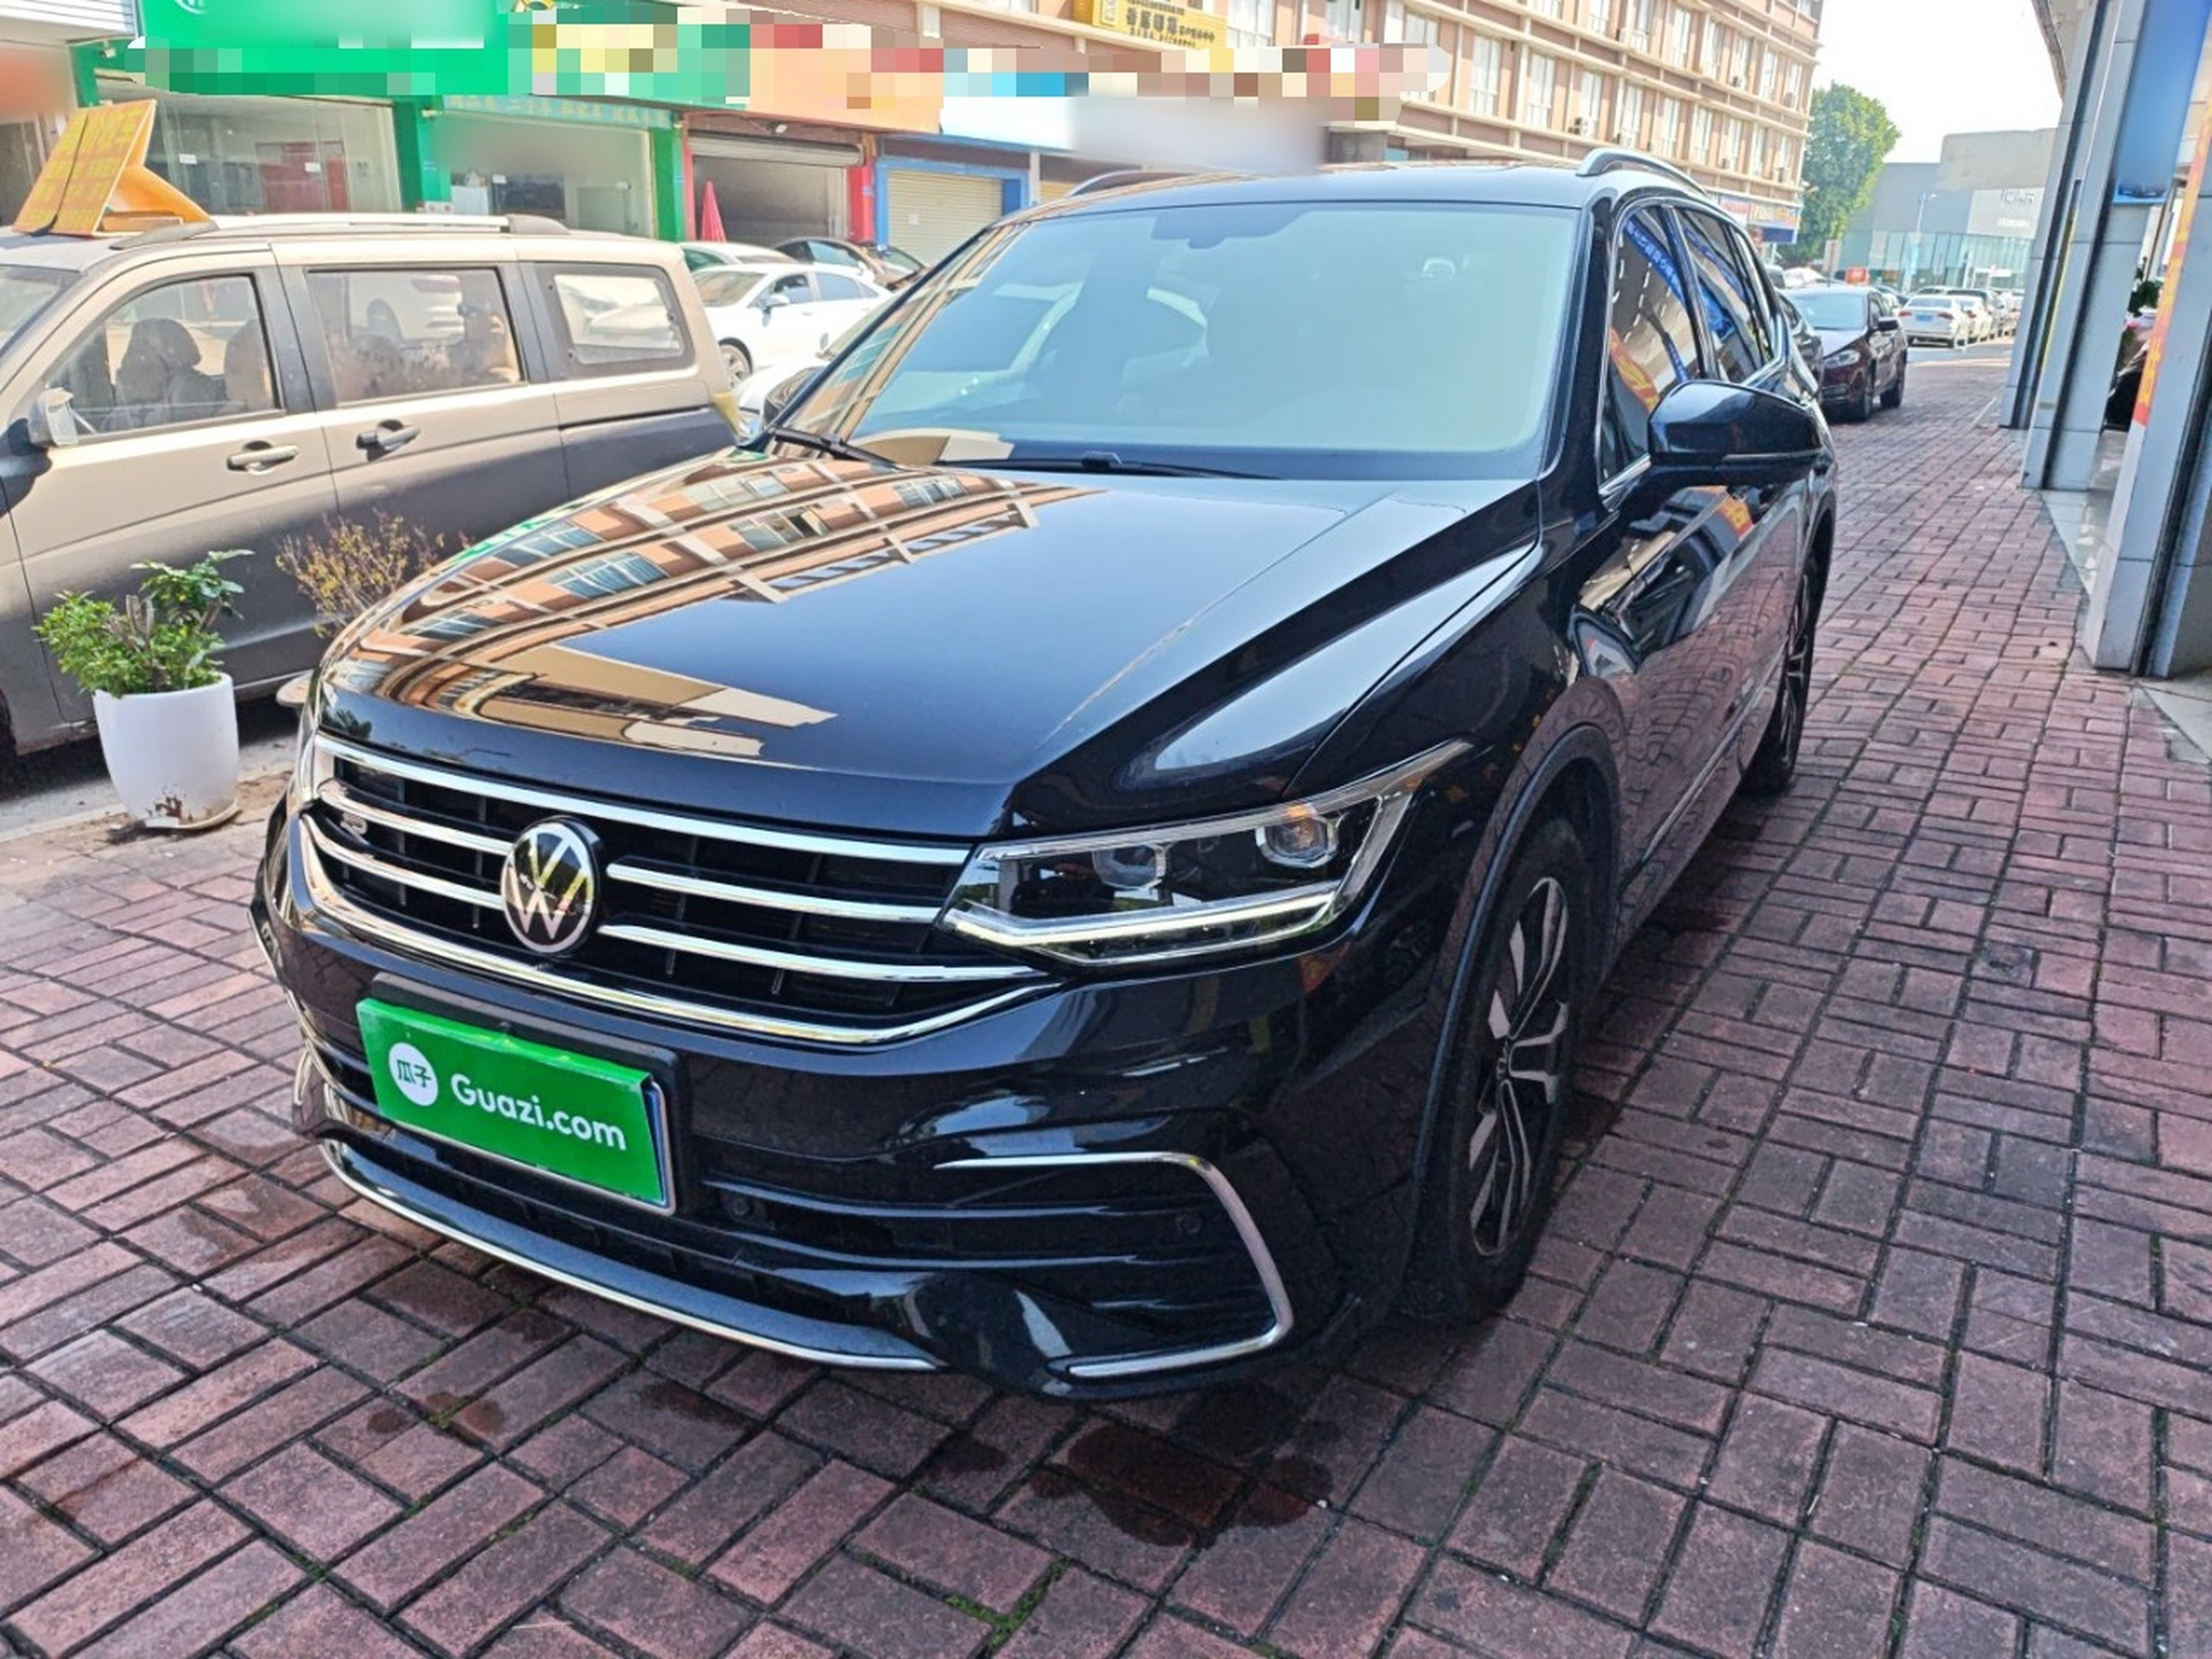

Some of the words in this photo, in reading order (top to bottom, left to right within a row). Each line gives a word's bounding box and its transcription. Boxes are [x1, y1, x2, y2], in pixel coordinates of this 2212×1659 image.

[501, 824, 593, 950] VW
[396, 1059, 431, 1088] 瓜子
[450, 1073, 626, 1150] Guazi.com
